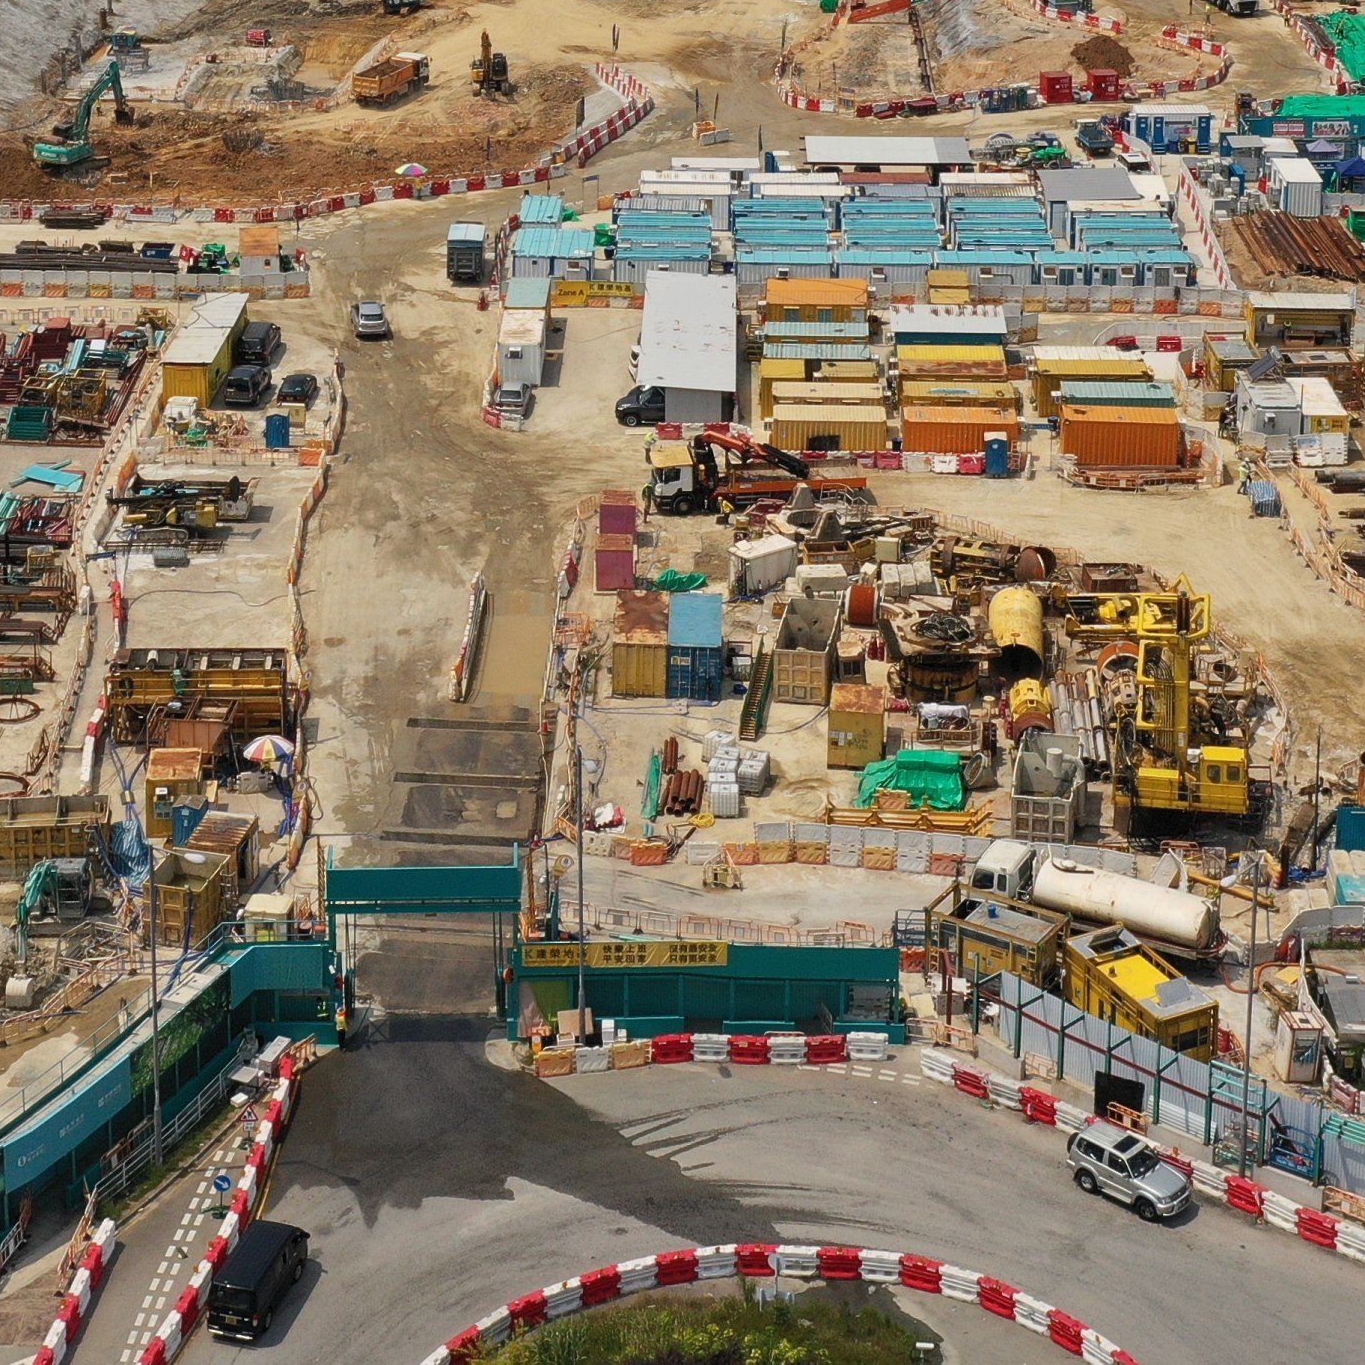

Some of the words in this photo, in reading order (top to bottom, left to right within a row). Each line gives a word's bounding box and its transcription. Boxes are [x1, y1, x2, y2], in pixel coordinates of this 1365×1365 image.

[557, 288, 576, 296] Zone
[578, 288, 585, 296] A
[602, 944, 647, 954] 快樂上班
[602, 954, 647, 964] 平安回家
